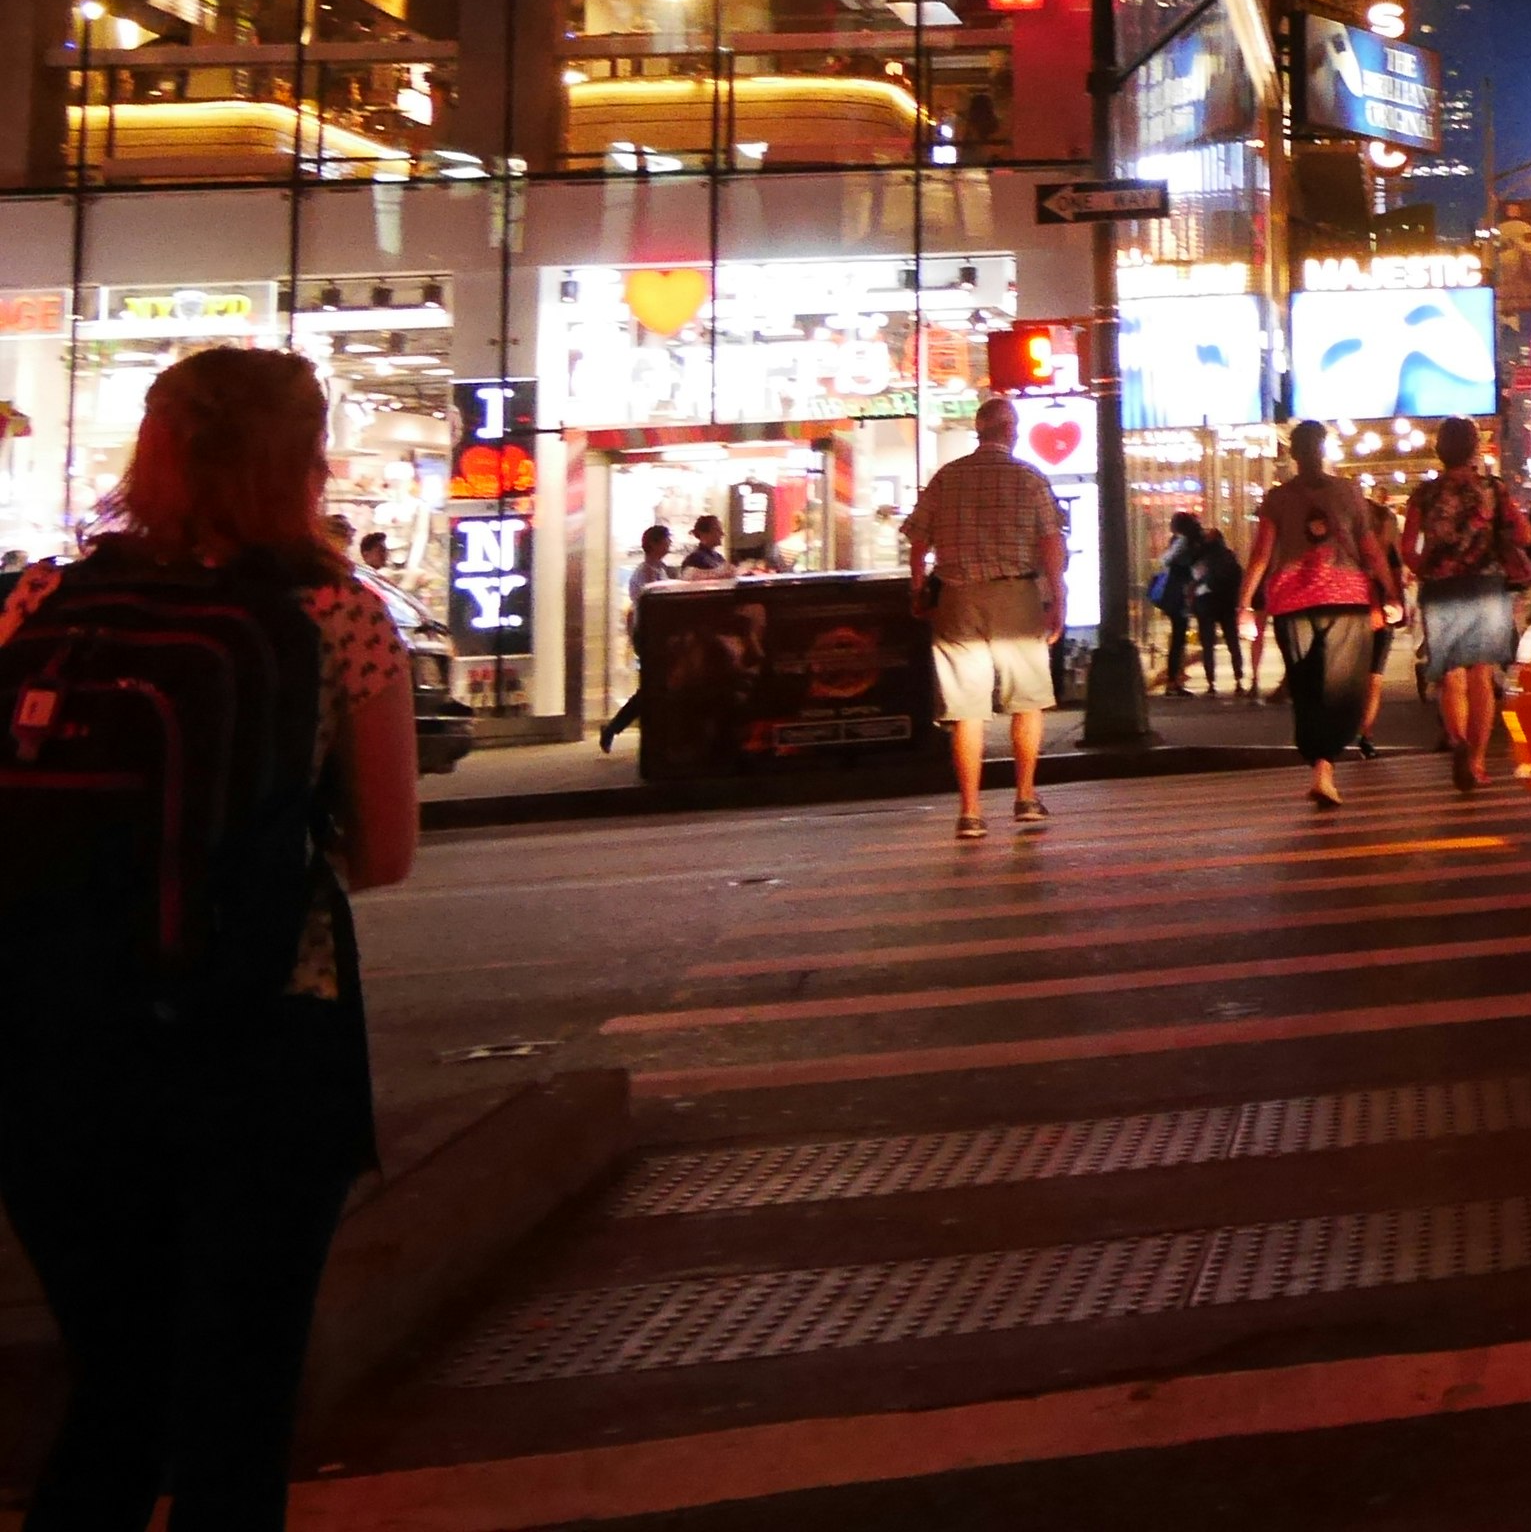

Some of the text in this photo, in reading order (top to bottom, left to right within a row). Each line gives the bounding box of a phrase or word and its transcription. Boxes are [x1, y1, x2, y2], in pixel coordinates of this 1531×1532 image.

[1058, 190, 1152, 212] ONE WAY
[1304, 254, 1483, 292] MAJESTIC
